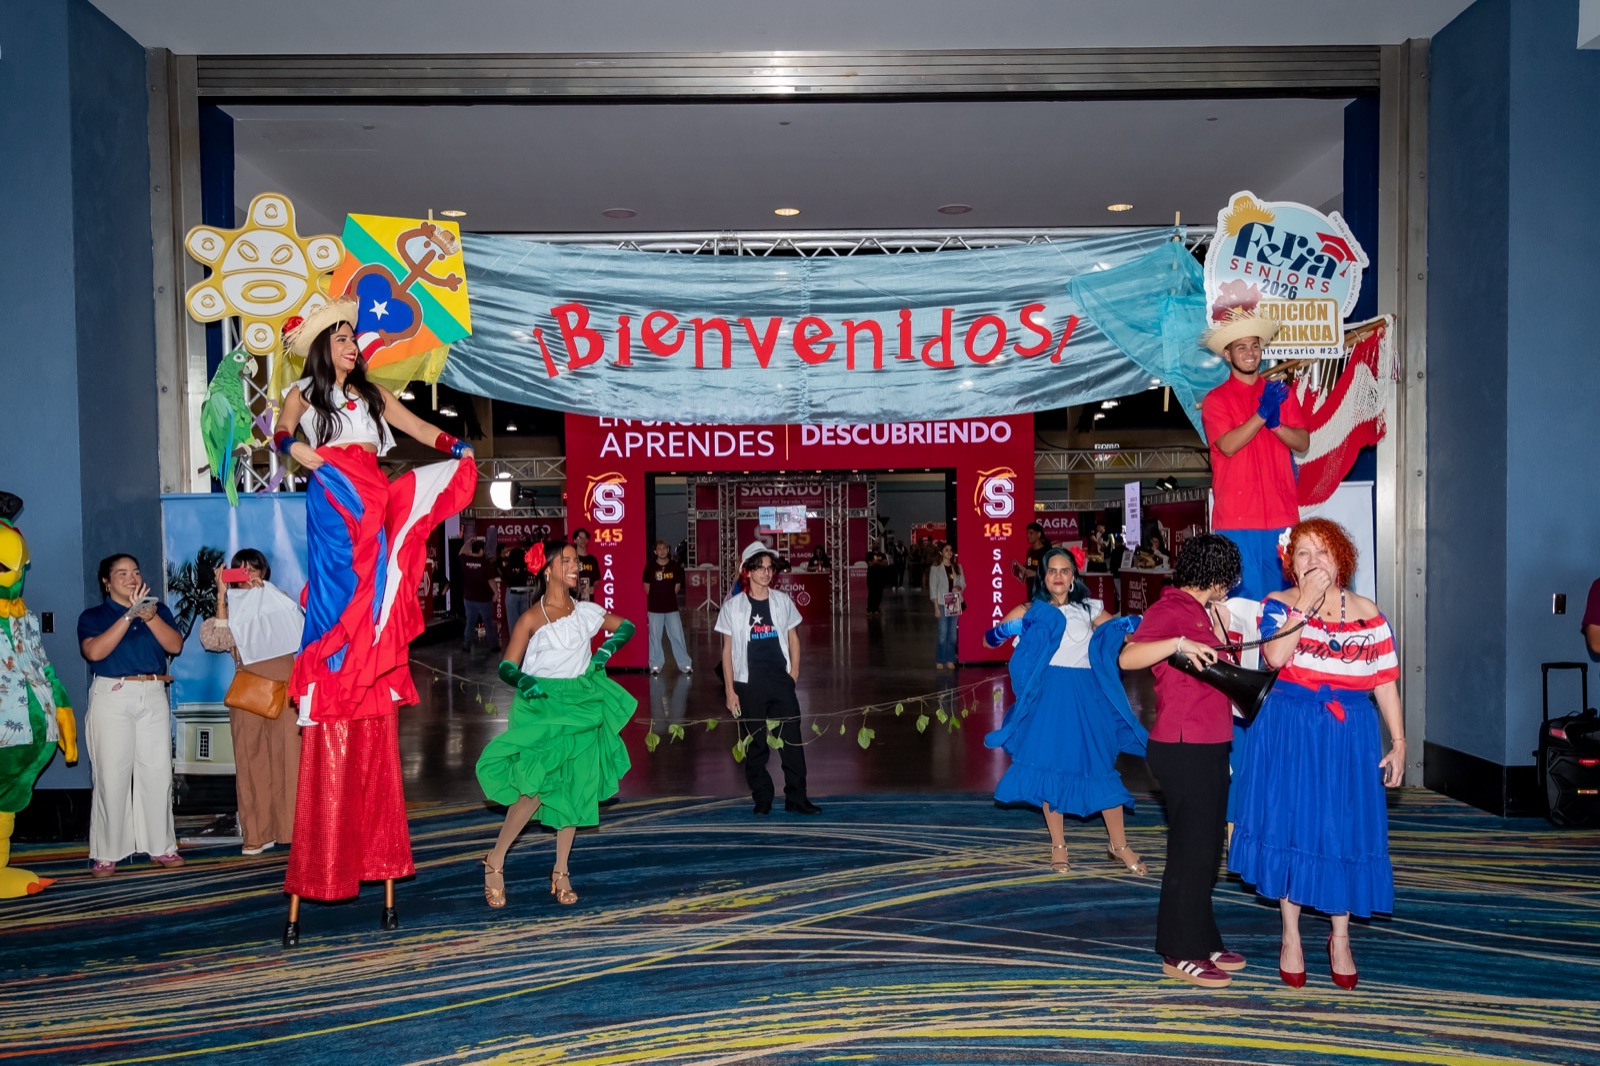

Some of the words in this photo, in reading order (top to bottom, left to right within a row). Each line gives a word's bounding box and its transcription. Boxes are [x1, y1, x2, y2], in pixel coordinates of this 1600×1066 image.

[1233, 221, 1338, 281] Feria
[1229, 258, 1331, 294] SENIORS
[1260, 278, 1299, 301] 2026
[533, 302, 1081, 378] ¡Bienvenidos!
[1275, 324, 1334, 342] RIKUA
[1262, 346, 1316, 355] niversario
[1319, 347, 1339, 355] #23
[599, 430, 775, 458] APRENDES
[801, 421, 1012, 446] DESCUBRIENDO
[593, 481, 625, 524] S
[741, 484, 822, 497] SAGRADO
[983, 476, 1015, 518] S
[984, 523, 1013, 537] 145
[1036, 517, 1078, 528] SAGRA
[594, 528, 623, 543] 145
[992, 548, 1004, 628] SAGRA
